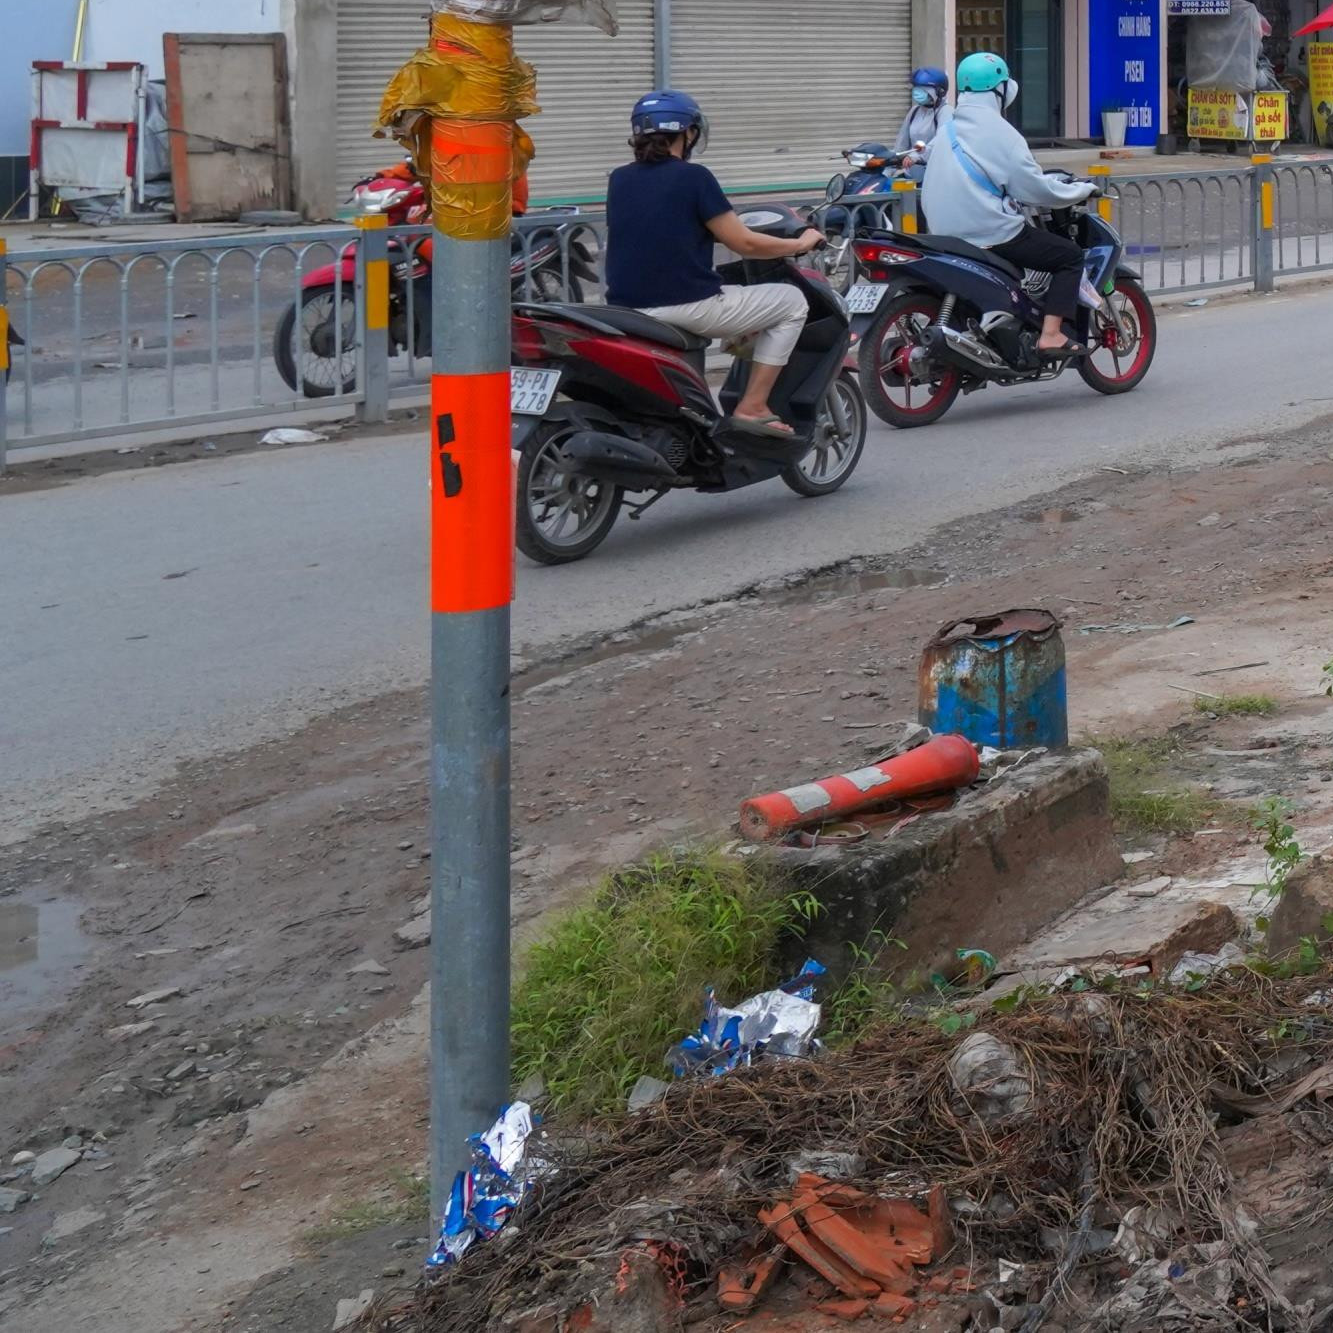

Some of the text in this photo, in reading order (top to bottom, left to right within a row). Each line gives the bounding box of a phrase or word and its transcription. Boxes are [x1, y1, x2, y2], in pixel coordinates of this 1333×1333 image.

[1124, 61, 1144, 82] PISEN
[1257, 97, 1279, 108] Chân
[1255, 109, 1281, 125] gà sốt
[1260, 126, 1276, 138] thái
